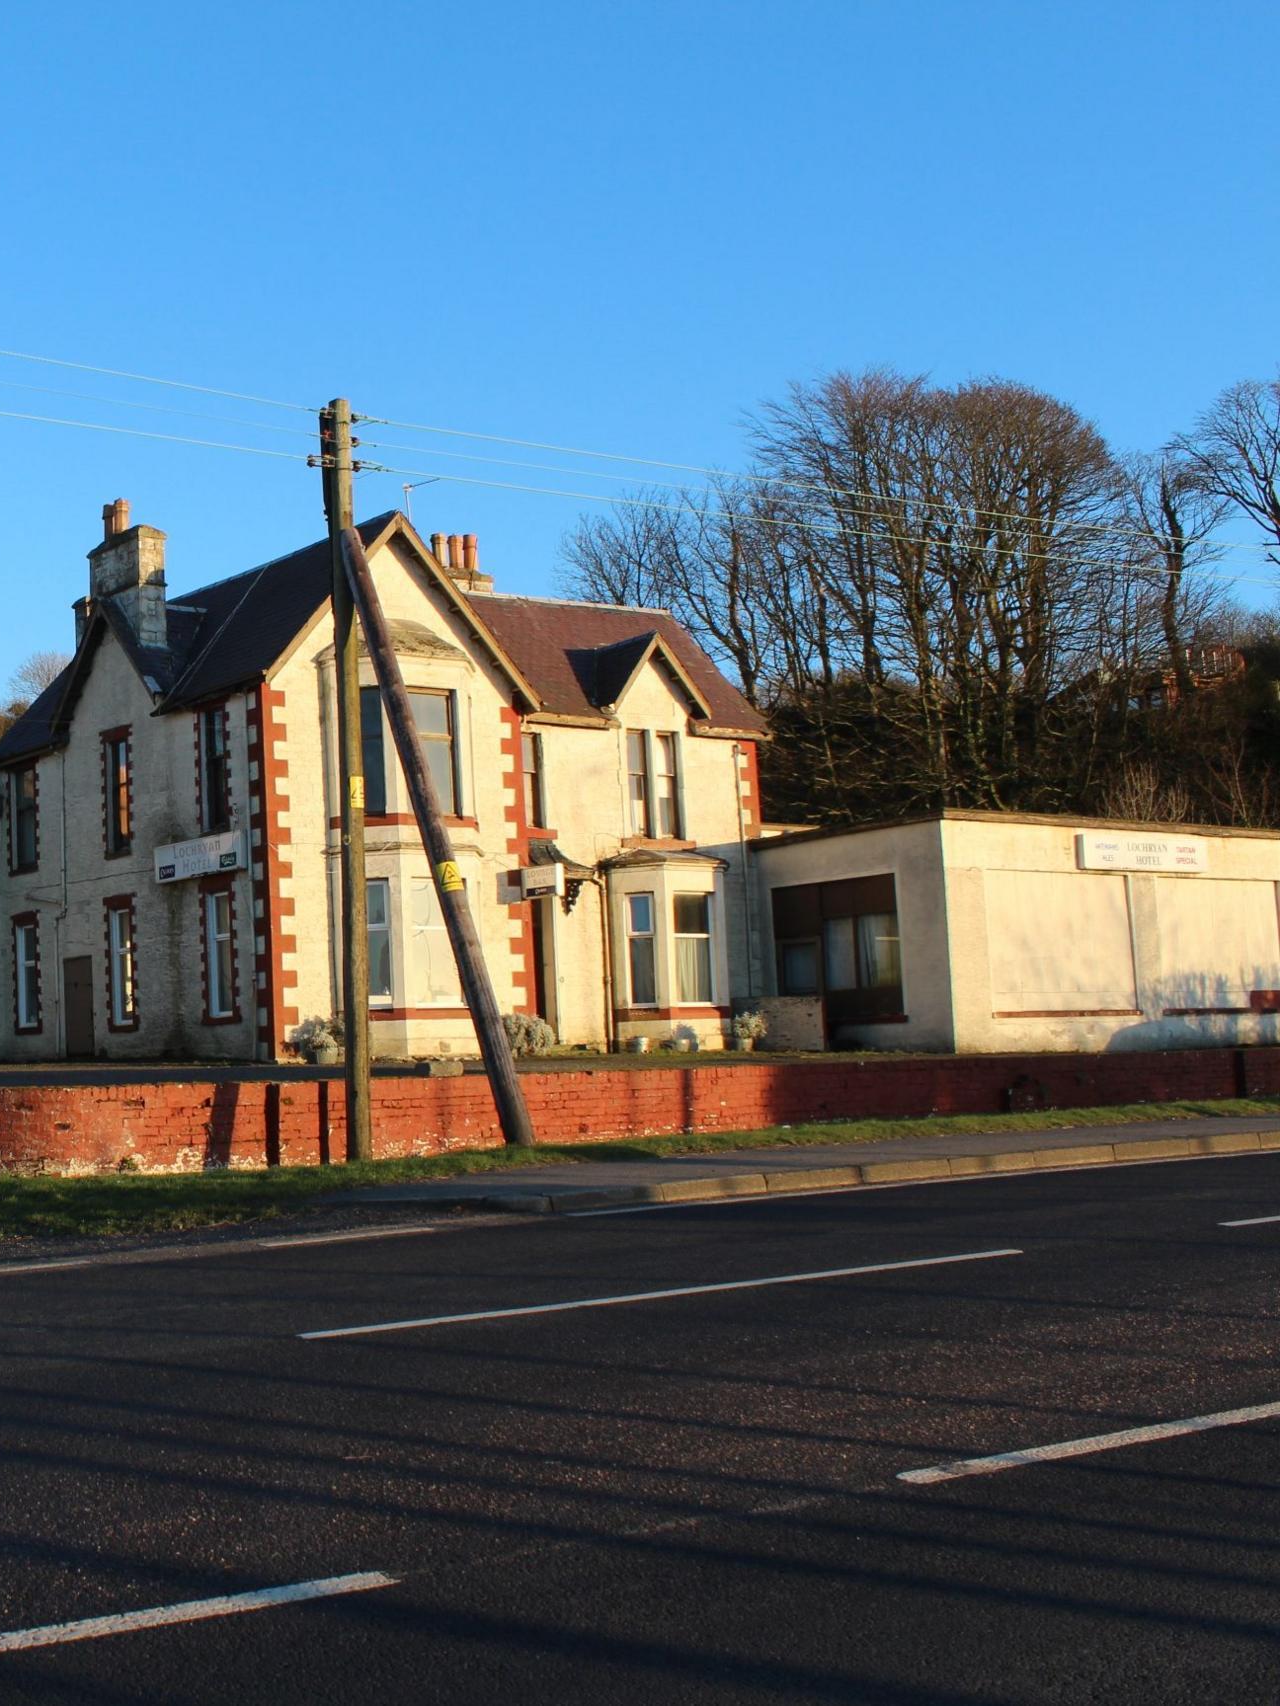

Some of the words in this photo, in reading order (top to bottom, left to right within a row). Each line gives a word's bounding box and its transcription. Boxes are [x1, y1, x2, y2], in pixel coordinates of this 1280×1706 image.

[173, 840, 220, 859] LOCHRYAN
[1127, 842, 1168, 853] LOCHRYAN
[182, 858, 217, 873] HOTEL
[1136, 855, 1162, 866] HOTEL
